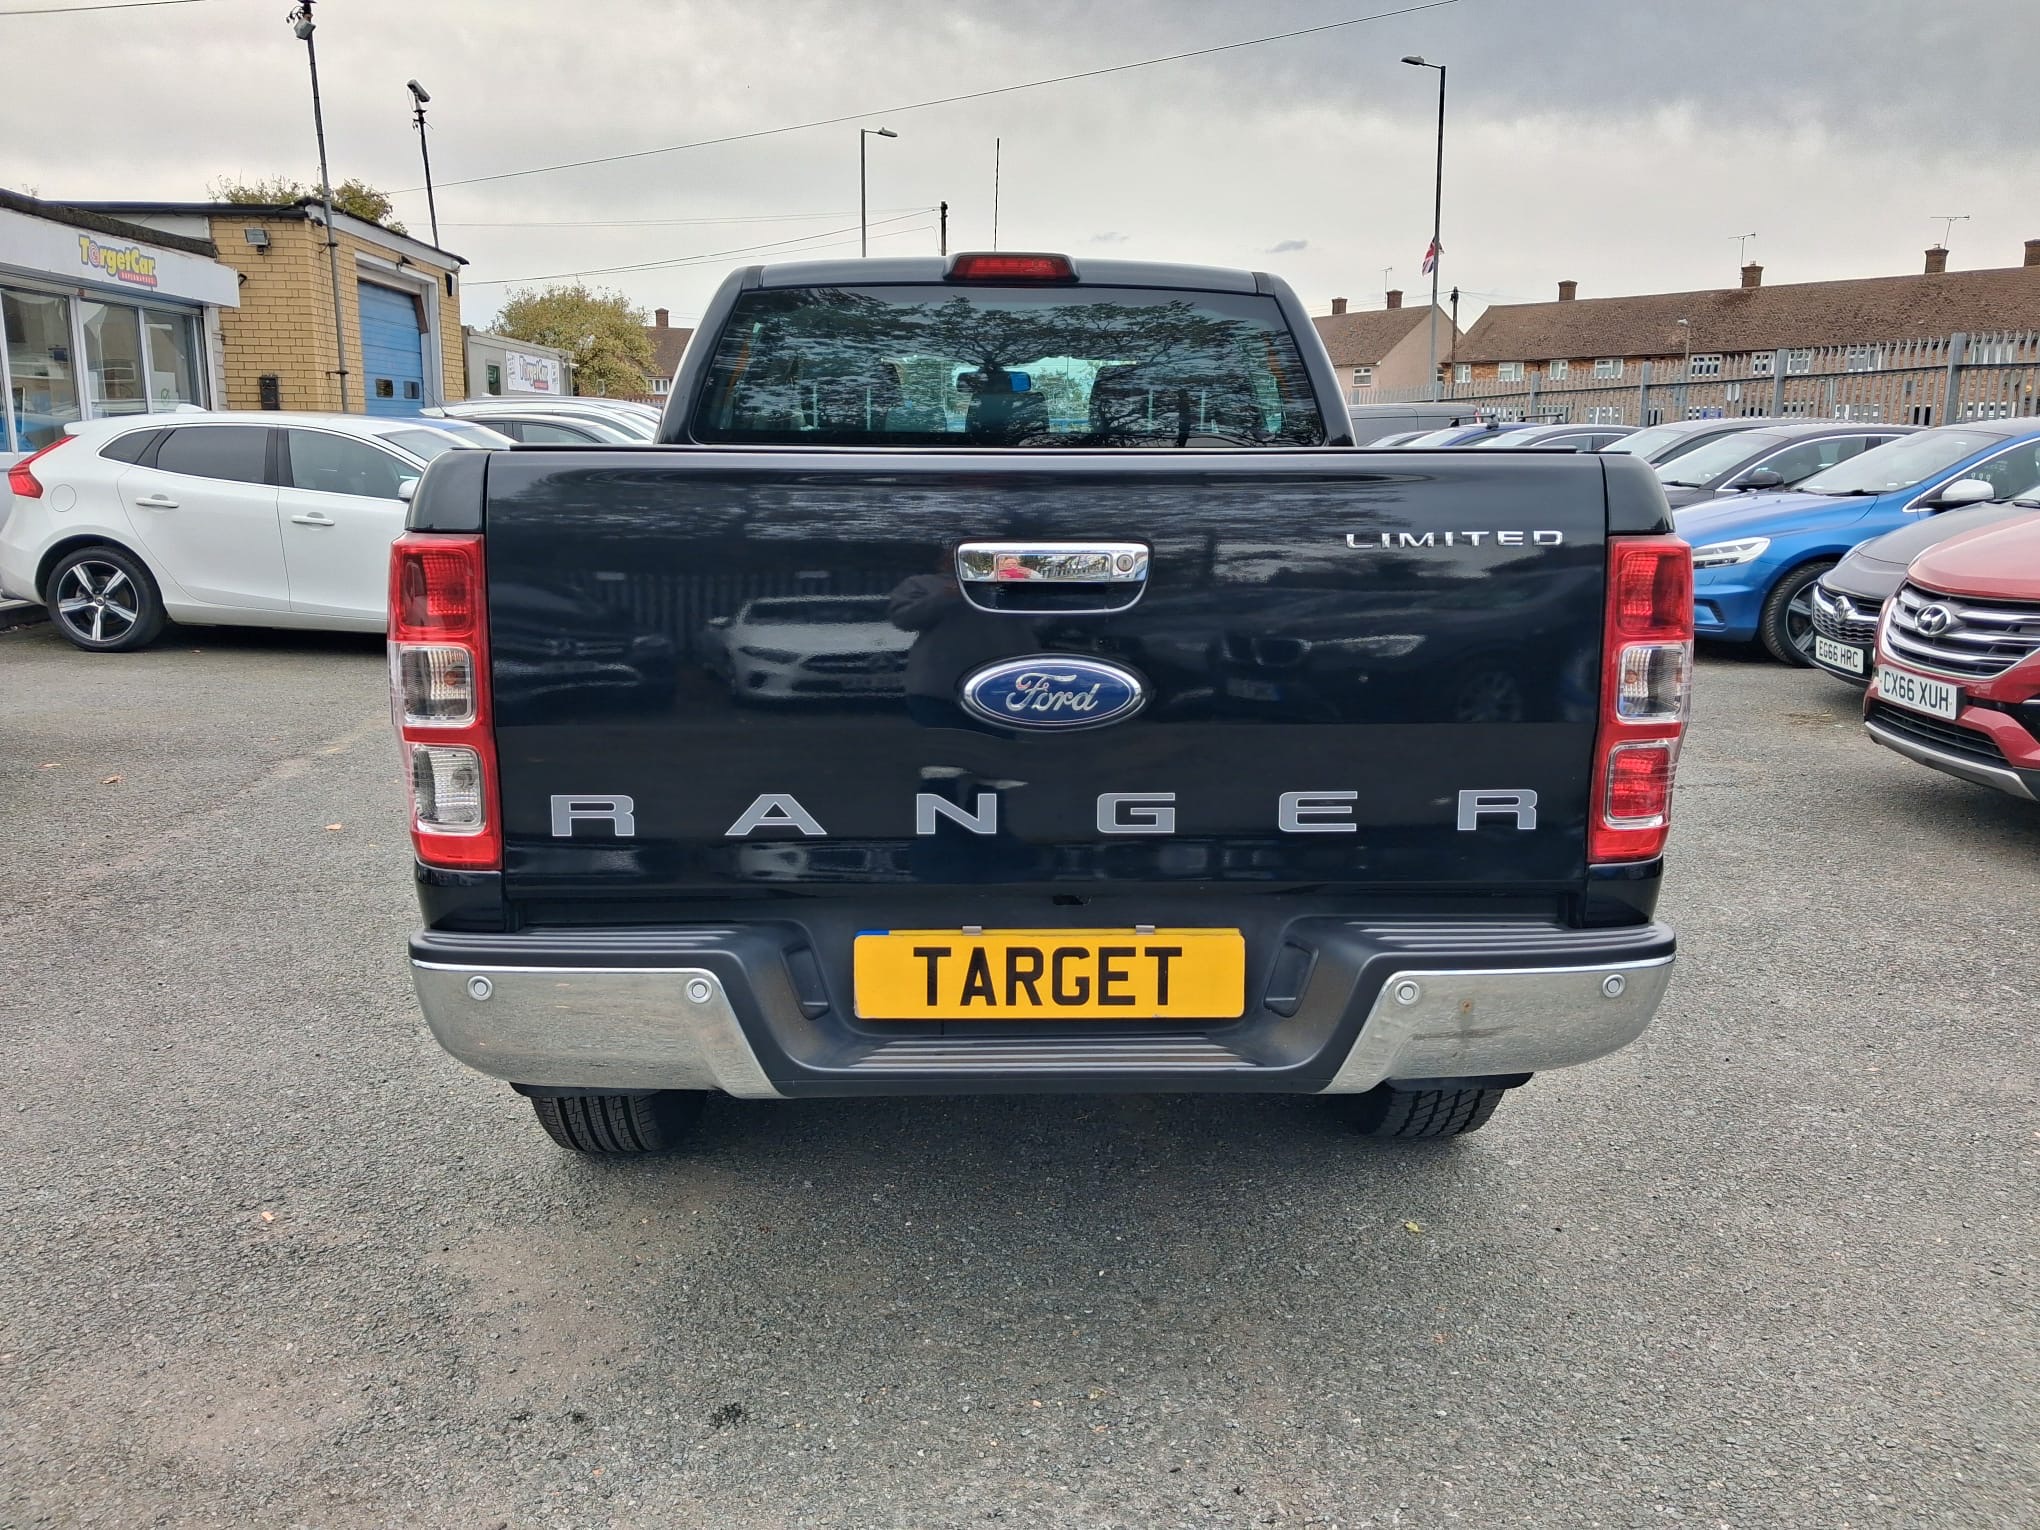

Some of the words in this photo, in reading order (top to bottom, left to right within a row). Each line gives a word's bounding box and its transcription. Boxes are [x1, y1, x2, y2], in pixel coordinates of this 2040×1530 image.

[1346, 530, 1564, 549] LIMITED
[1819, 640, 1838, 666] EG66
[1841, 647, 1858, 669] HRC
[1006, 672, 1100, 711] Ford
[1883, 671, 1914, 699] CX66
[1919, 681, 1949, 713] XUH
[550, 789, 1538, 838] RANGER
[913, 946, 1183, 1006] TARGET
